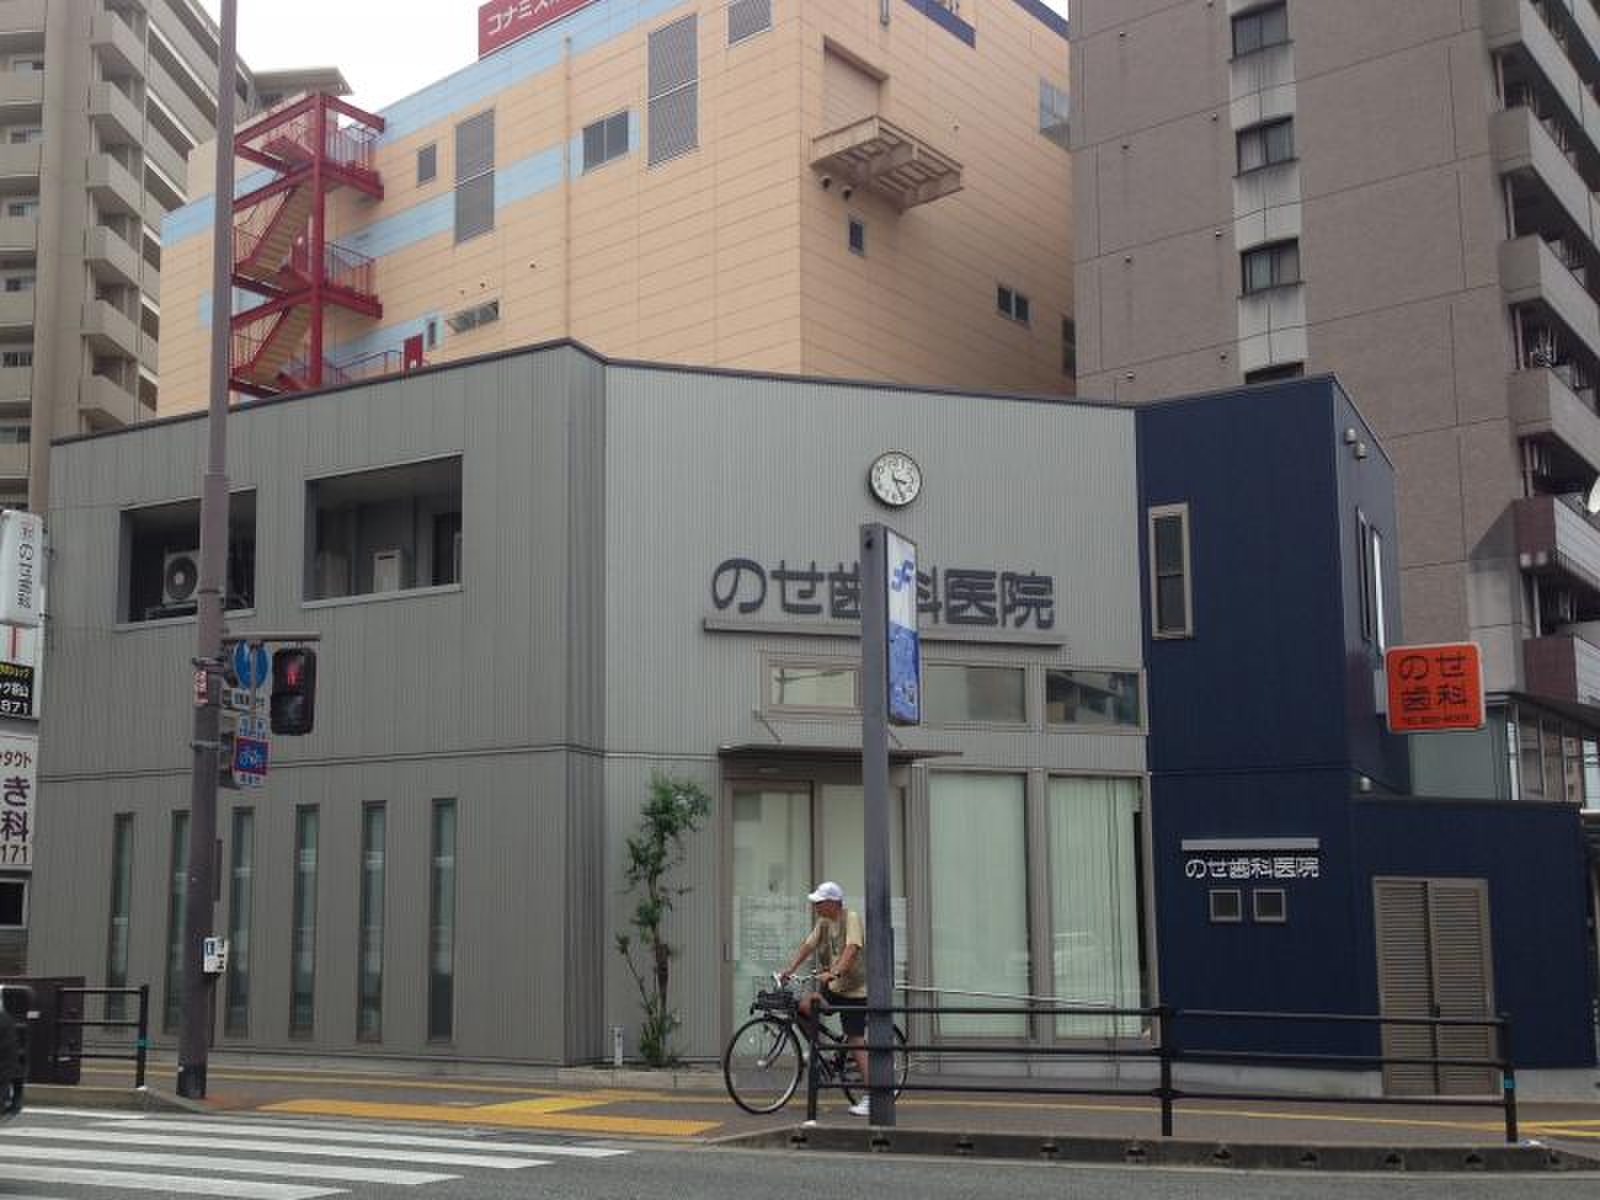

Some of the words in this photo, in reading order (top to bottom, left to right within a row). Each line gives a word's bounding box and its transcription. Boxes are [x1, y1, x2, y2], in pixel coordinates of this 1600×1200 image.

[487, 0, 562, 35] コナミス
[1399, 653, 1466, 679] のせ
[1401, 682, 1468, 712] 歯科
[0, 751, 32, 768] タクト
[1185, 857, 1319, 879] のせ歯科医院
